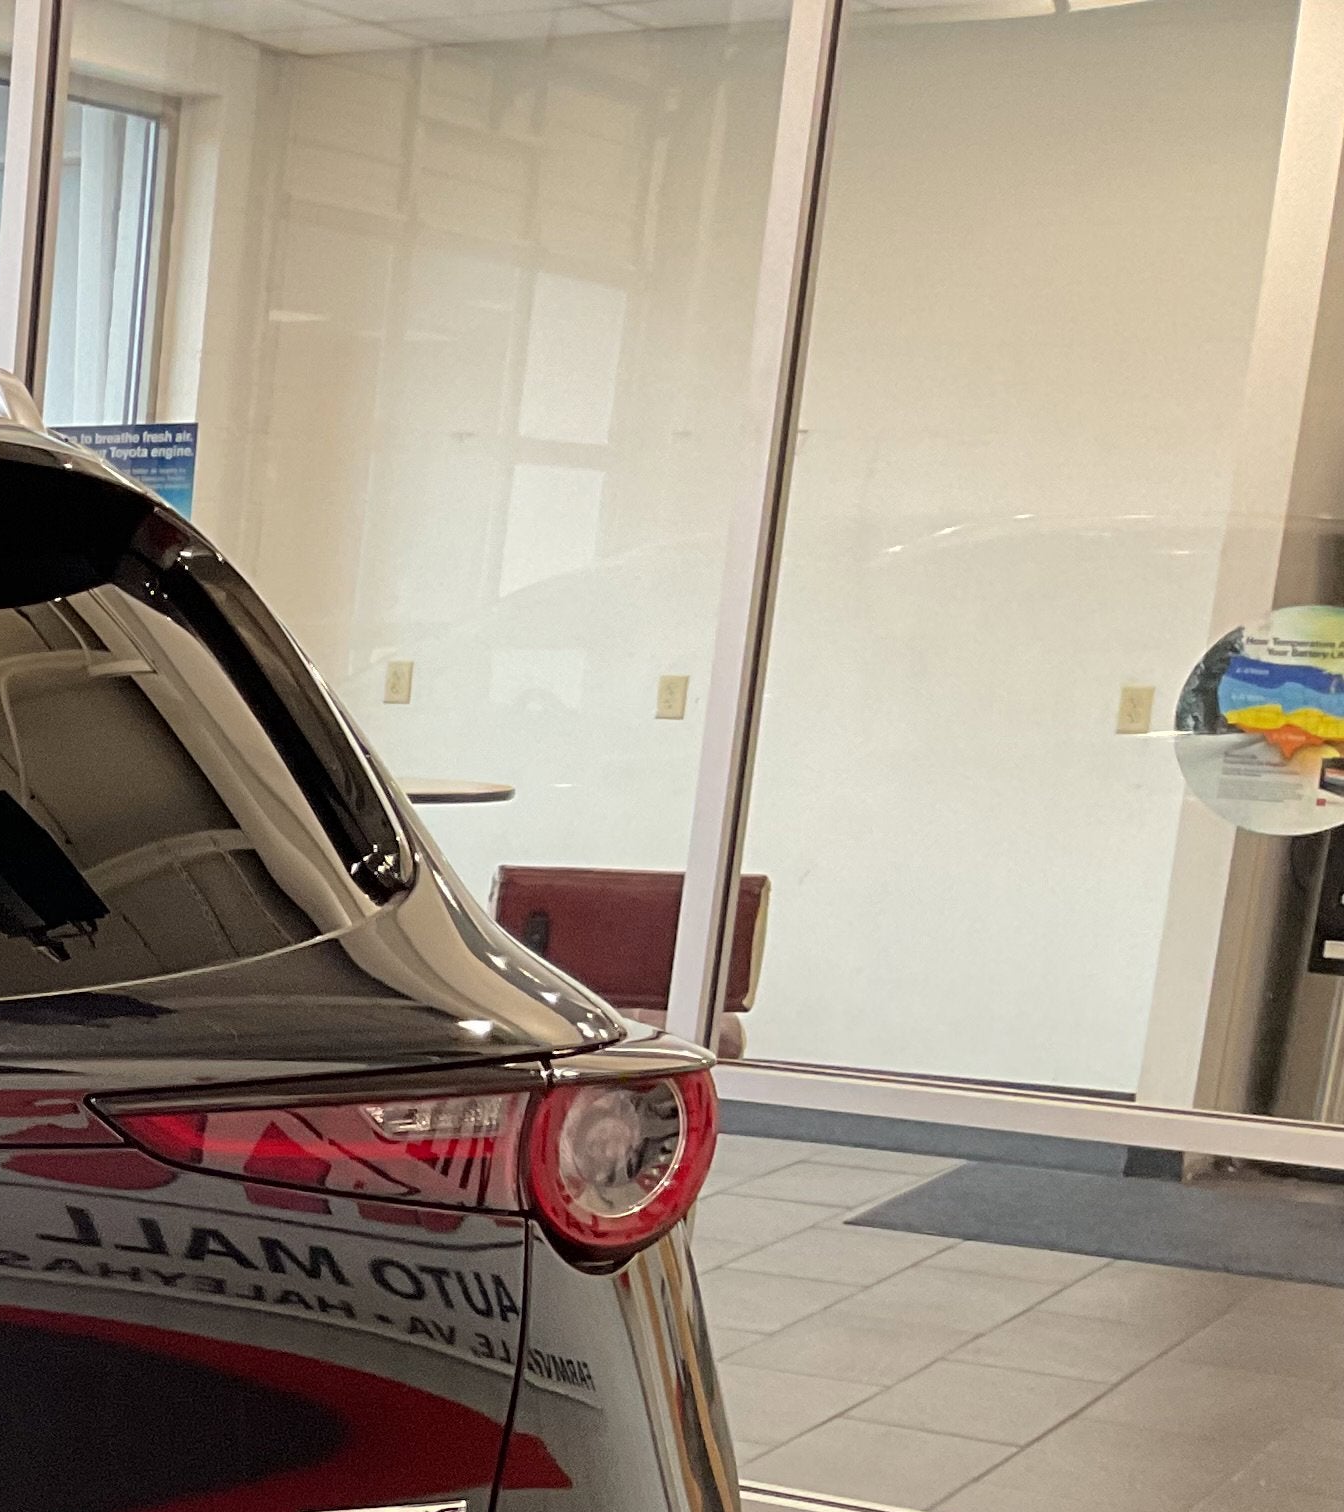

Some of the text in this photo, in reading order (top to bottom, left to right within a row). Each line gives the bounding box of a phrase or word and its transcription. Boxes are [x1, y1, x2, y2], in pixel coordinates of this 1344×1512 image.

[81, 434, 92, 444] to
[95, 432, 139, 444] breathe
[142, 430, 172, 443] fresh
[175, 430, 193, 442] air.
[109, 446, 149, 460] Toyota
[151, 446, 194, 460] engine.
